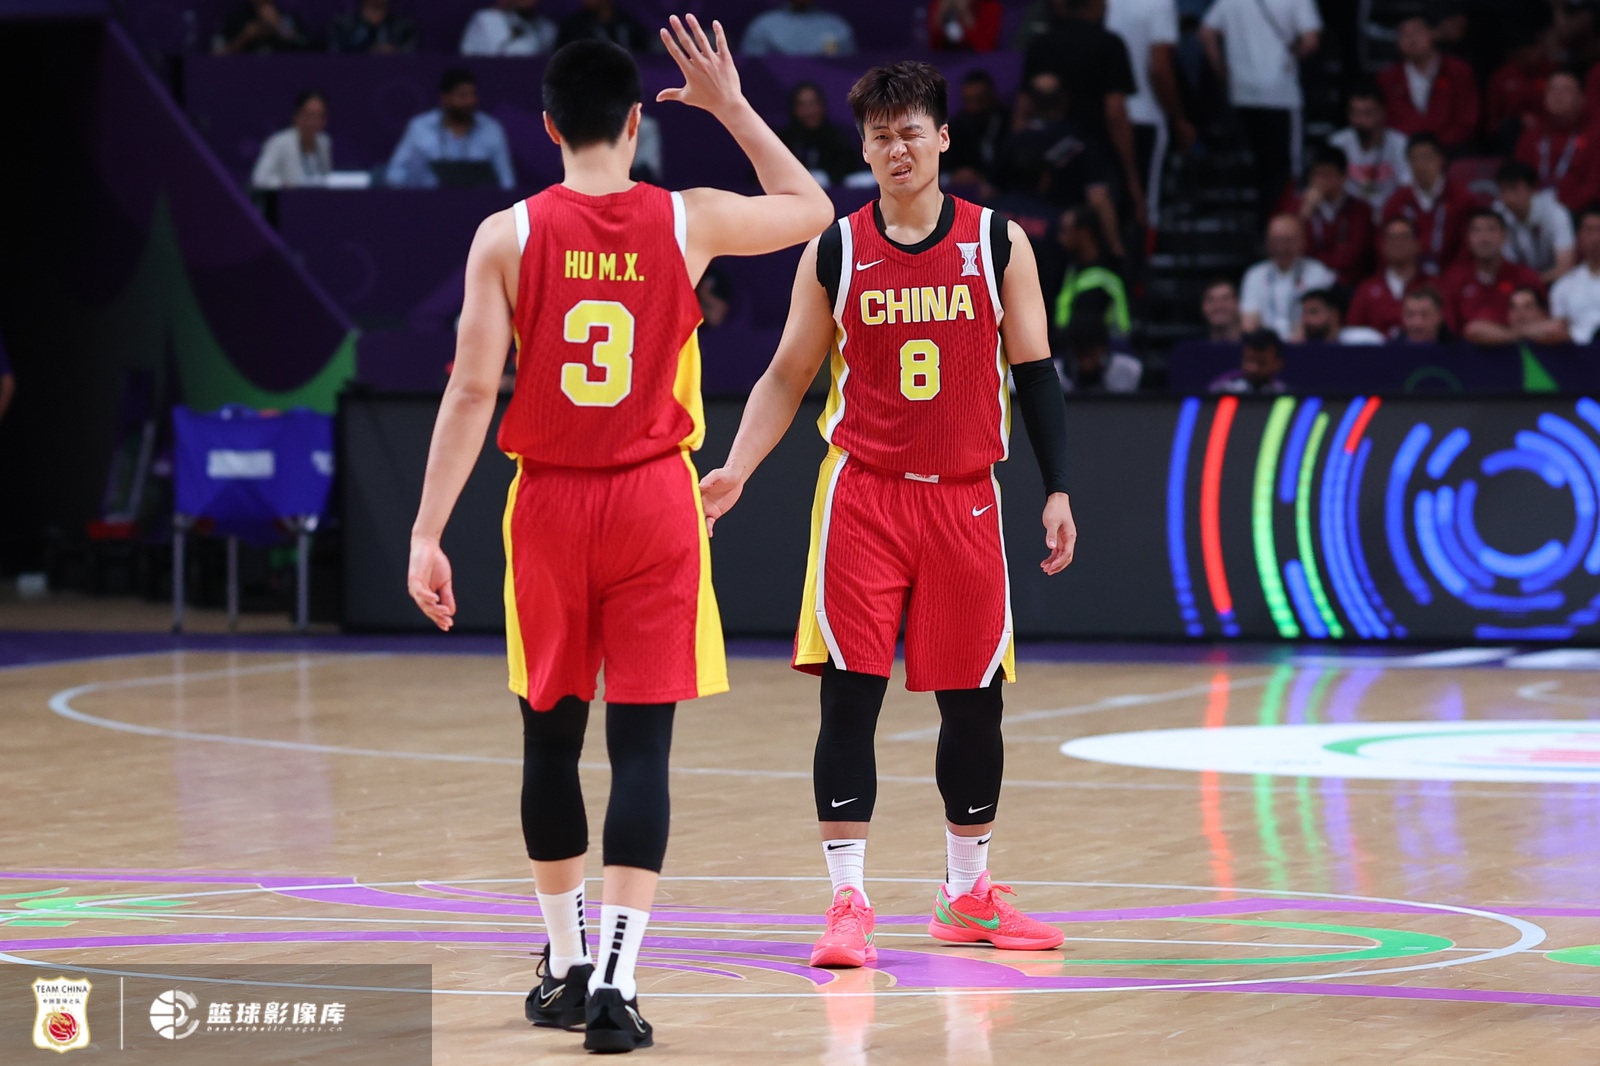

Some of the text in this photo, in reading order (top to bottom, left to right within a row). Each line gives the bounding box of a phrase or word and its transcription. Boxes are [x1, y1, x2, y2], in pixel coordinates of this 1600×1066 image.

[565, 250, 645, 281] HU M.X.
[860, 284, 975, 326] CHINA
[560, 300, 635, 407] 3
[900, 339, 940, 401] 8
